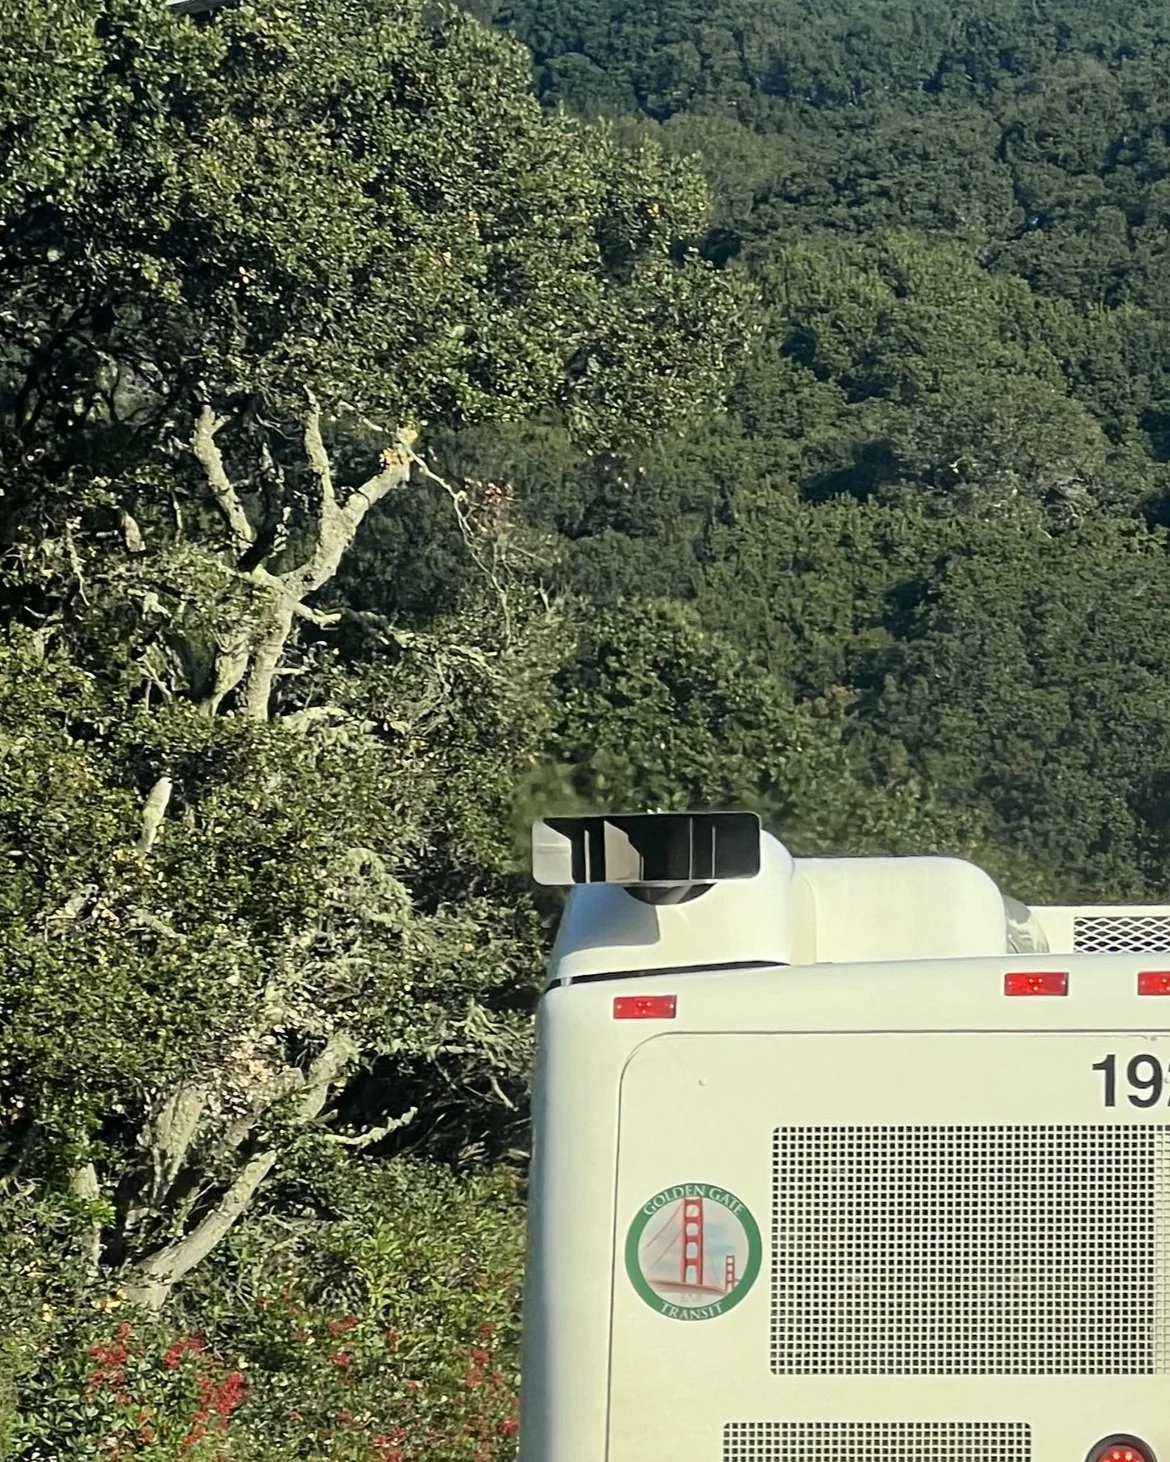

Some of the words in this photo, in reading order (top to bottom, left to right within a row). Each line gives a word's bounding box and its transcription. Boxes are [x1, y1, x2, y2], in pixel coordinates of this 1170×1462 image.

[643, 1184, 705, 1216] GOLDEN
[708, 1186, 744, 1216] GATE
[660, 1302, 723, 1321] TRANSIT
